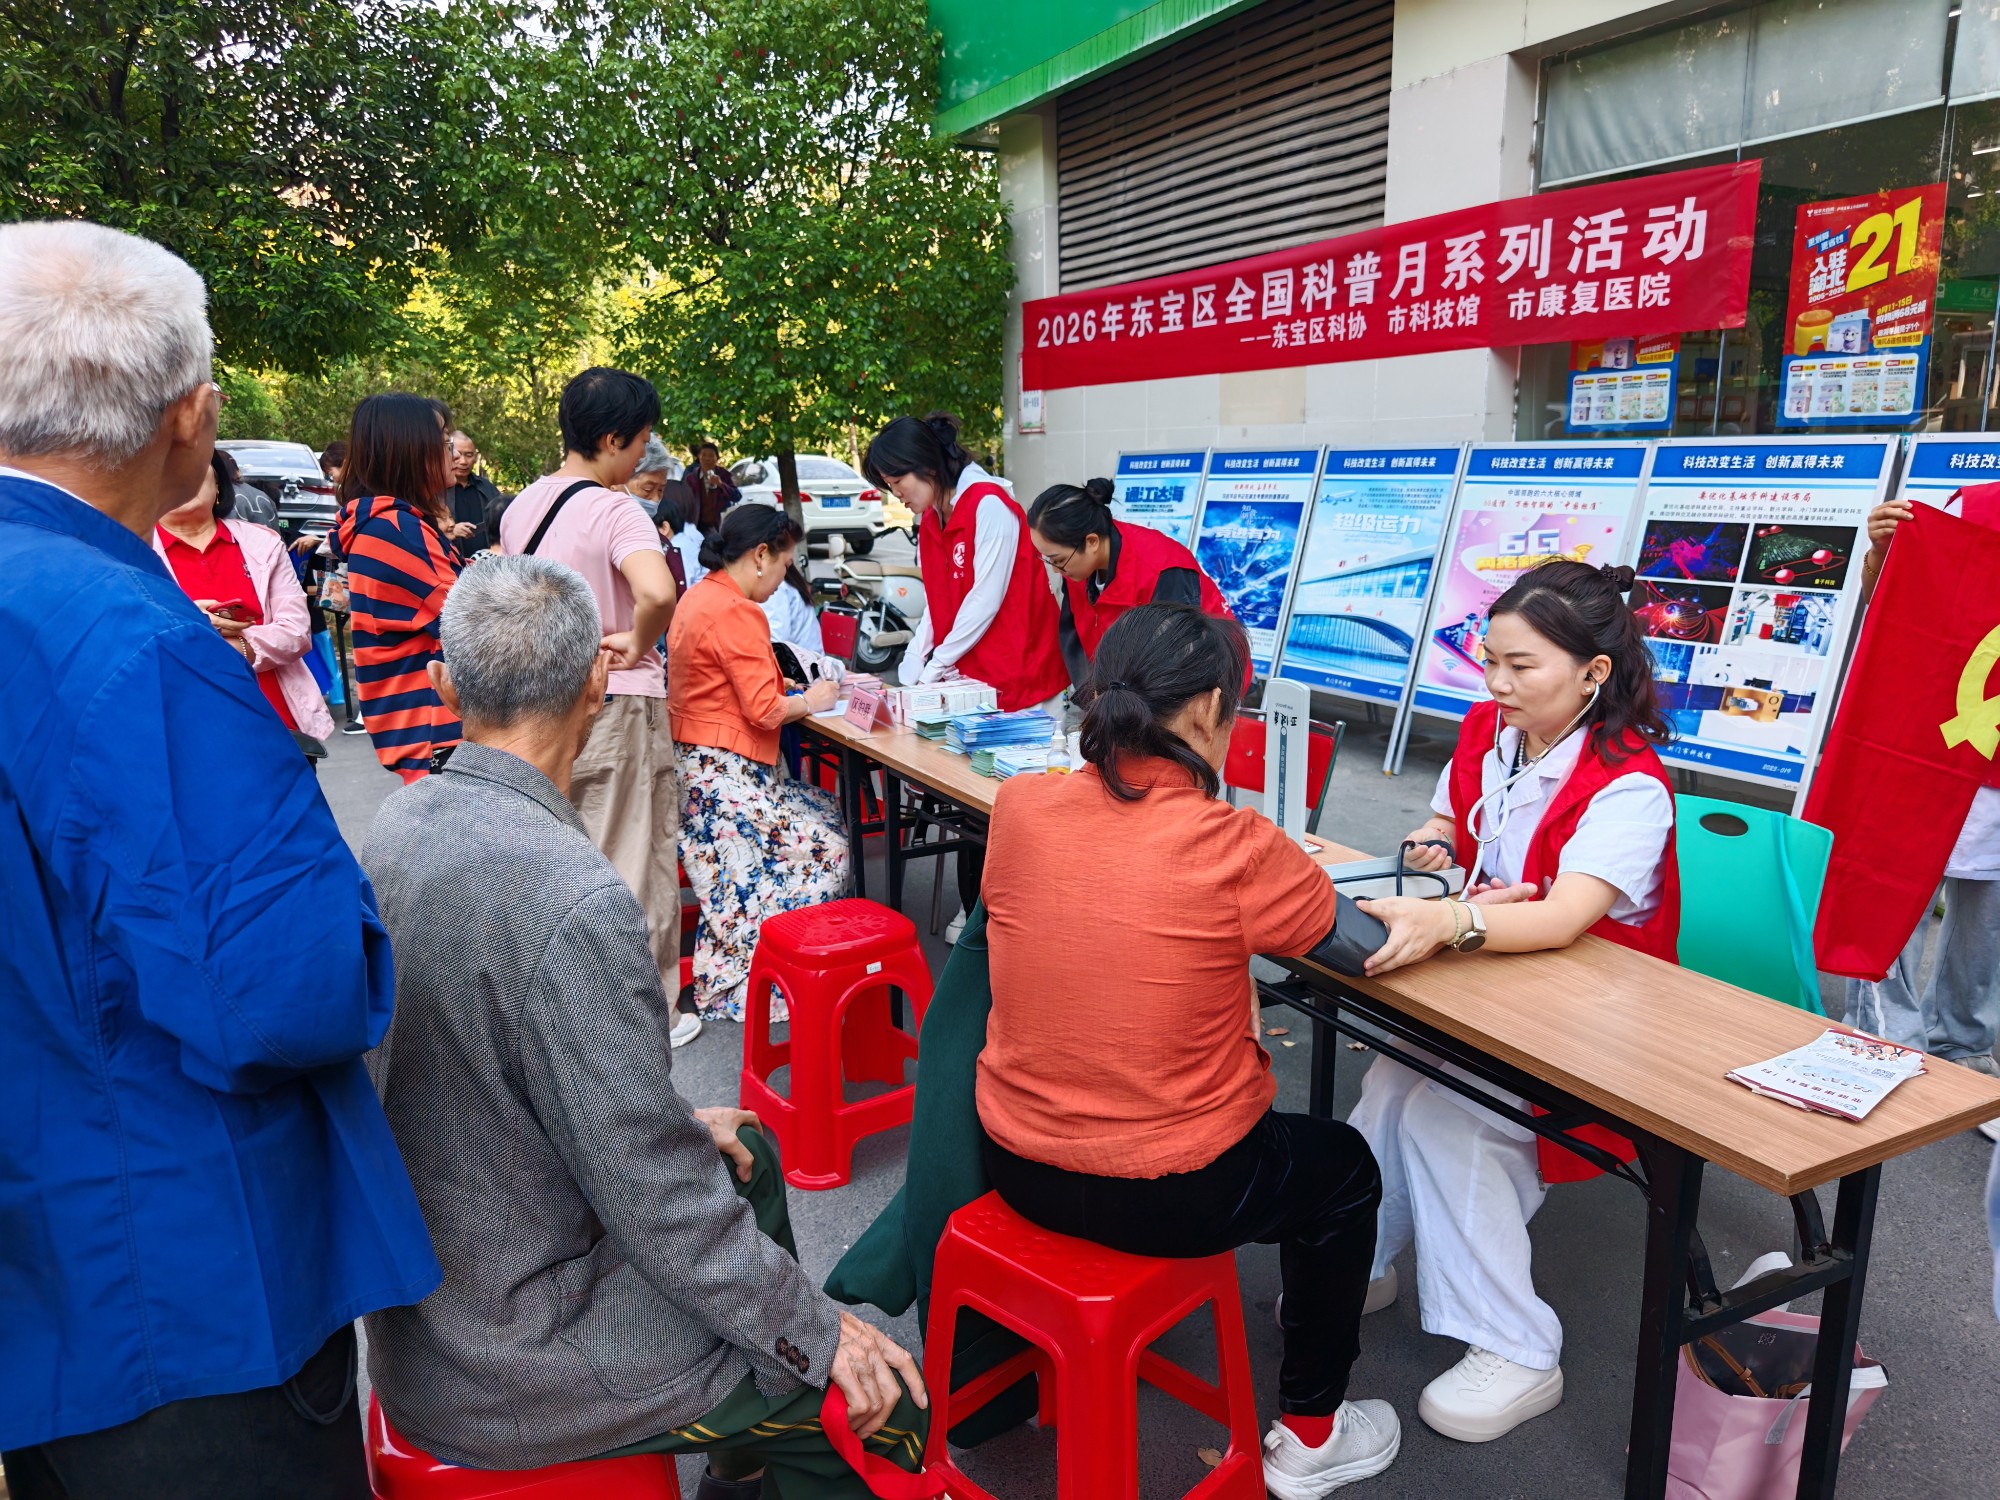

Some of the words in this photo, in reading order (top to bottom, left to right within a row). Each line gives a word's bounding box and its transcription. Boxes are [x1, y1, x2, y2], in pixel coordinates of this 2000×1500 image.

[1845, 196, 1922, 293] 21
[1037, 196, 1708, 348] 2026年东宝区全国科普月系列活动
[1810, 248, 1848, 277] 入驻
[1808, 268, 1846, 296] 湖北
[1387, 294, 1481, 335] 市科技馆
[1507, 271, 1671, 321] 市康复医院
[1224, 458, 1259, 469] 科技改变生活
[1343, 457, 1386, 468] 科技改变生活
[1390, 457, 1437, 468] 创新赢得未来
[1491, 457, 1547, 469] 科技改变生活
[1553, 457, 1614, 470] 创新赢得未来
[1682, 455, 1756, 470] 科技改变生活
[1765, 455, 1845, 470] 创新赢得未来
[1949, 453, 2000, 469] 科技改
[1125, 485, 1186, 503] 通江达海
[1698, 490, 1812, 503] 要优化基础学科建设布局
[1332, 512, 1421, 535] 超级运力
[1499, 528, 1560, 556] 6G
